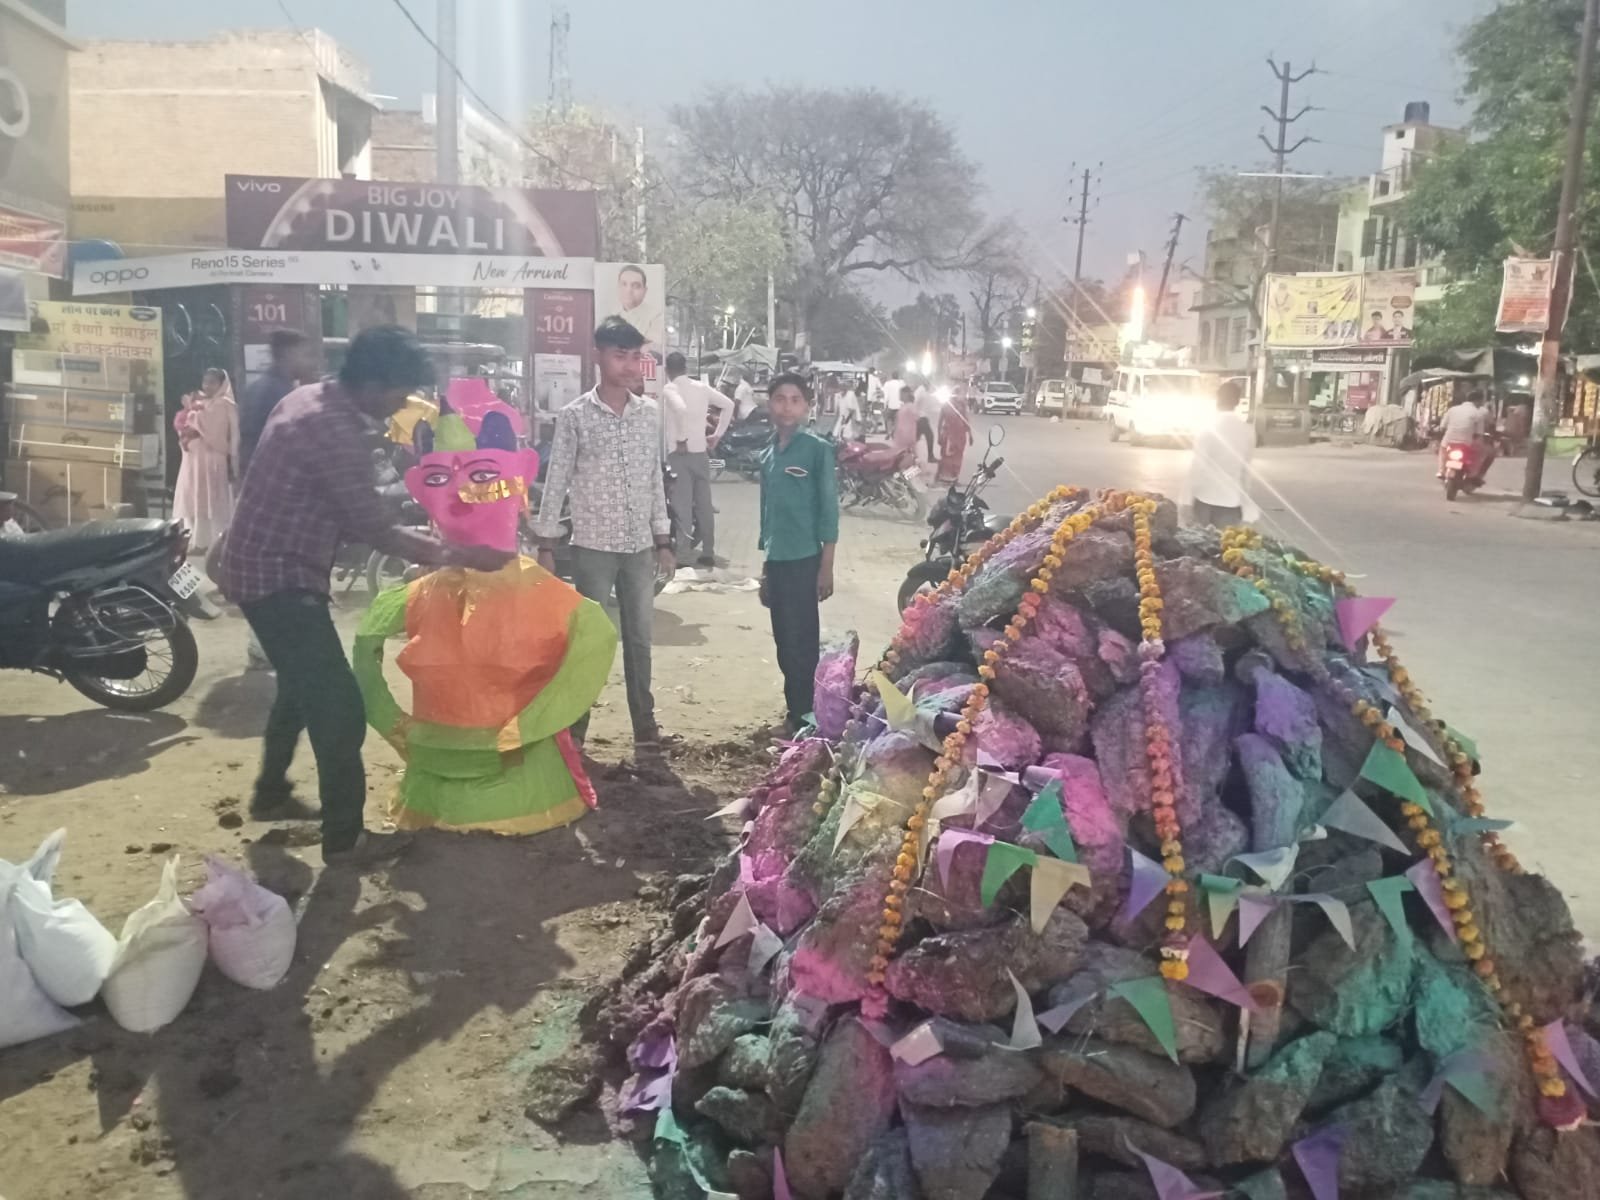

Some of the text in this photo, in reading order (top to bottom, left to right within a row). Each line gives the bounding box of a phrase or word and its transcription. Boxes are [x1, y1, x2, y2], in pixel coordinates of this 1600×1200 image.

[237, 180, 281, 192] vivo
[367, 185, 461, 209] BIG JOY
[326, 208, 504, 251] DIWALI
[191, 255, 239, 270] Reno15
[241, 254, 286, 269] Series
[89, 266, 149, 286] oppo
[512, 262, 568, 283] Arrival
[254, 303, 286, 321] 101
[543, 315, 574, 334] 101
